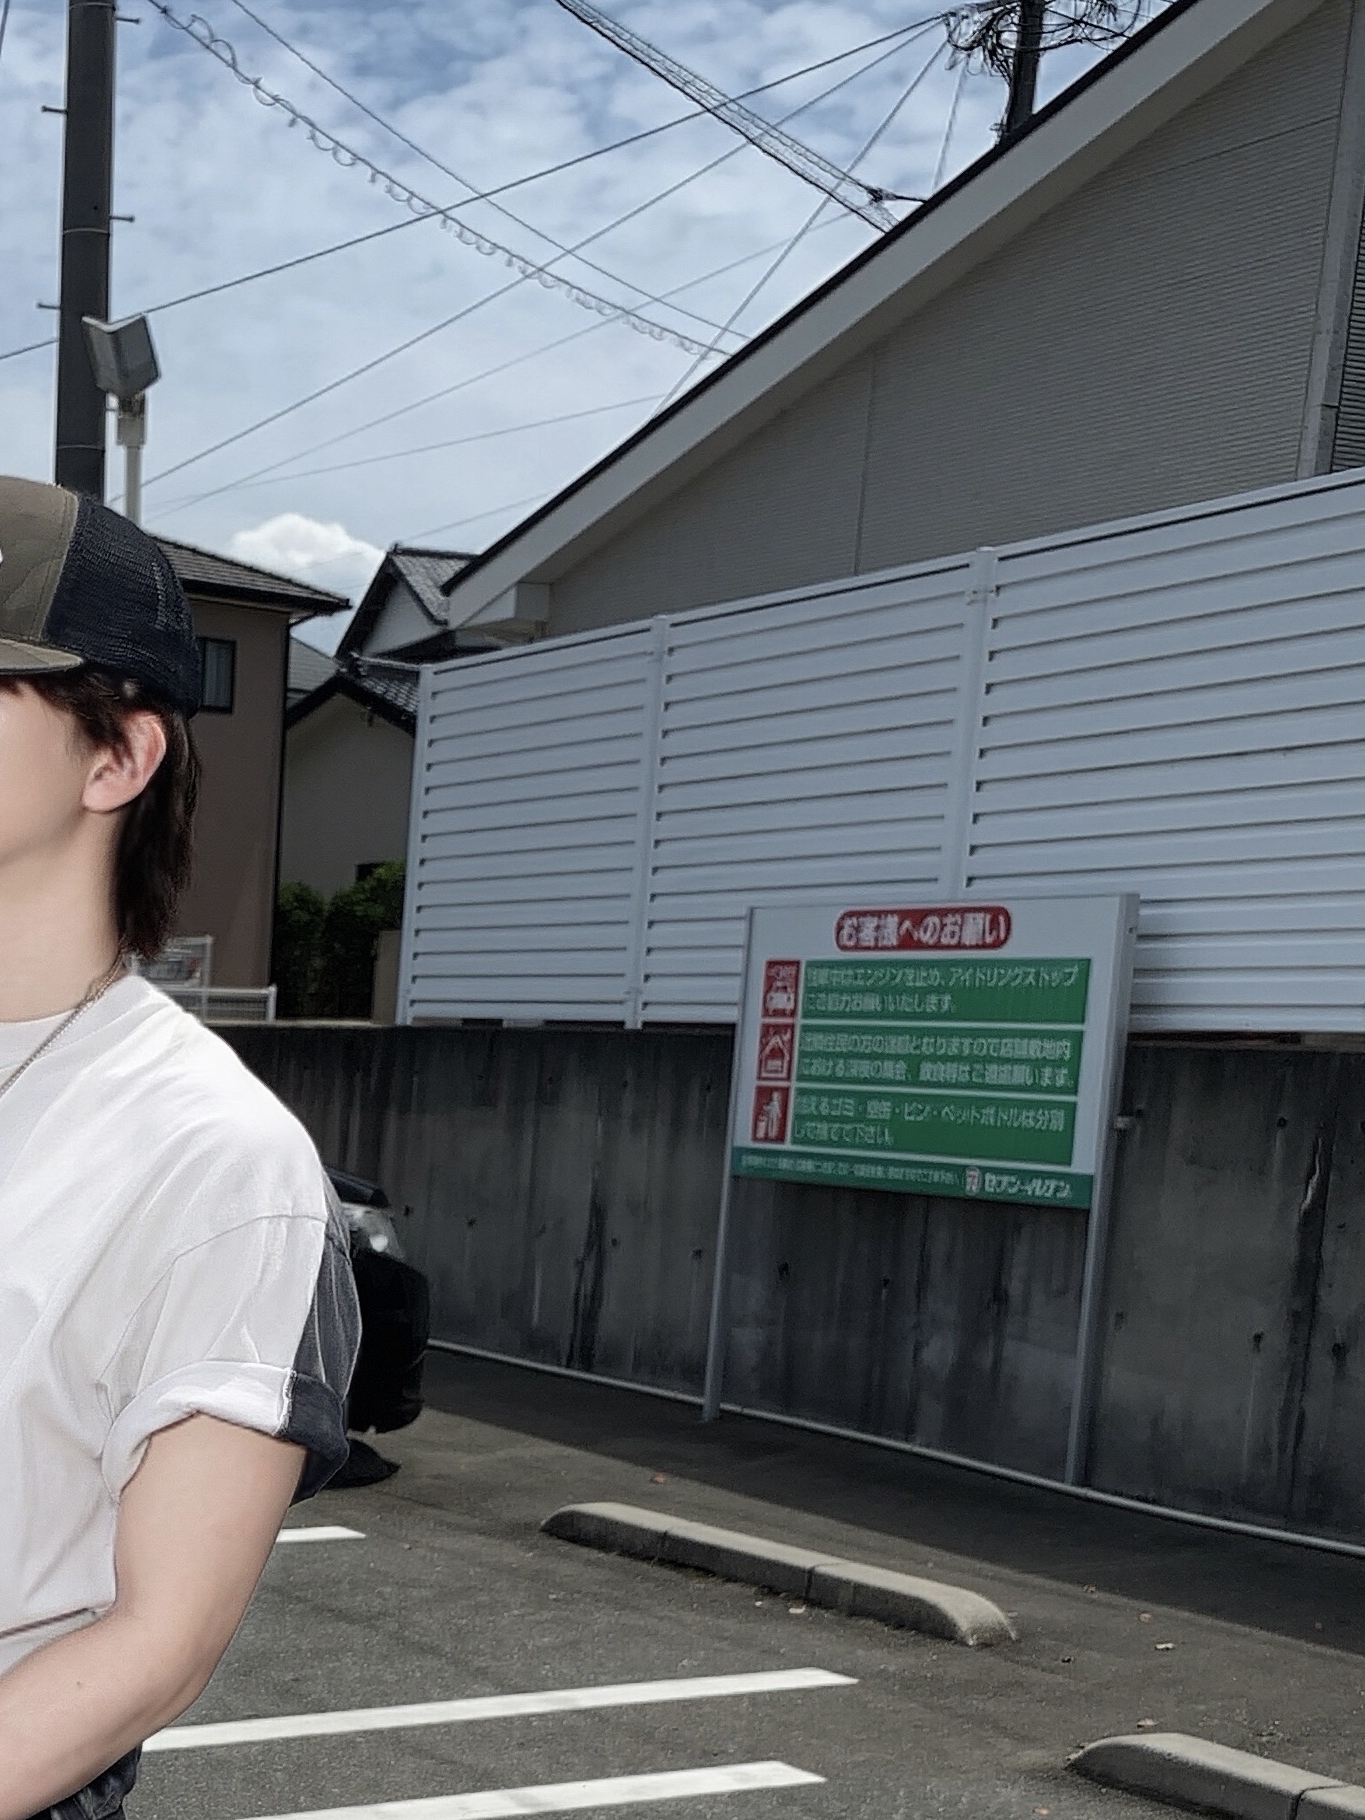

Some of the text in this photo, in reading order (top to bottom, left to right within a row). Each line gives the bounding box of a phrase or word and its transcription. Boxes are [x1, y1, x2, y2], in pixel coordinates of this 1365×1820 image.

[839, 912, 1006, 946] お客様へのお願い
